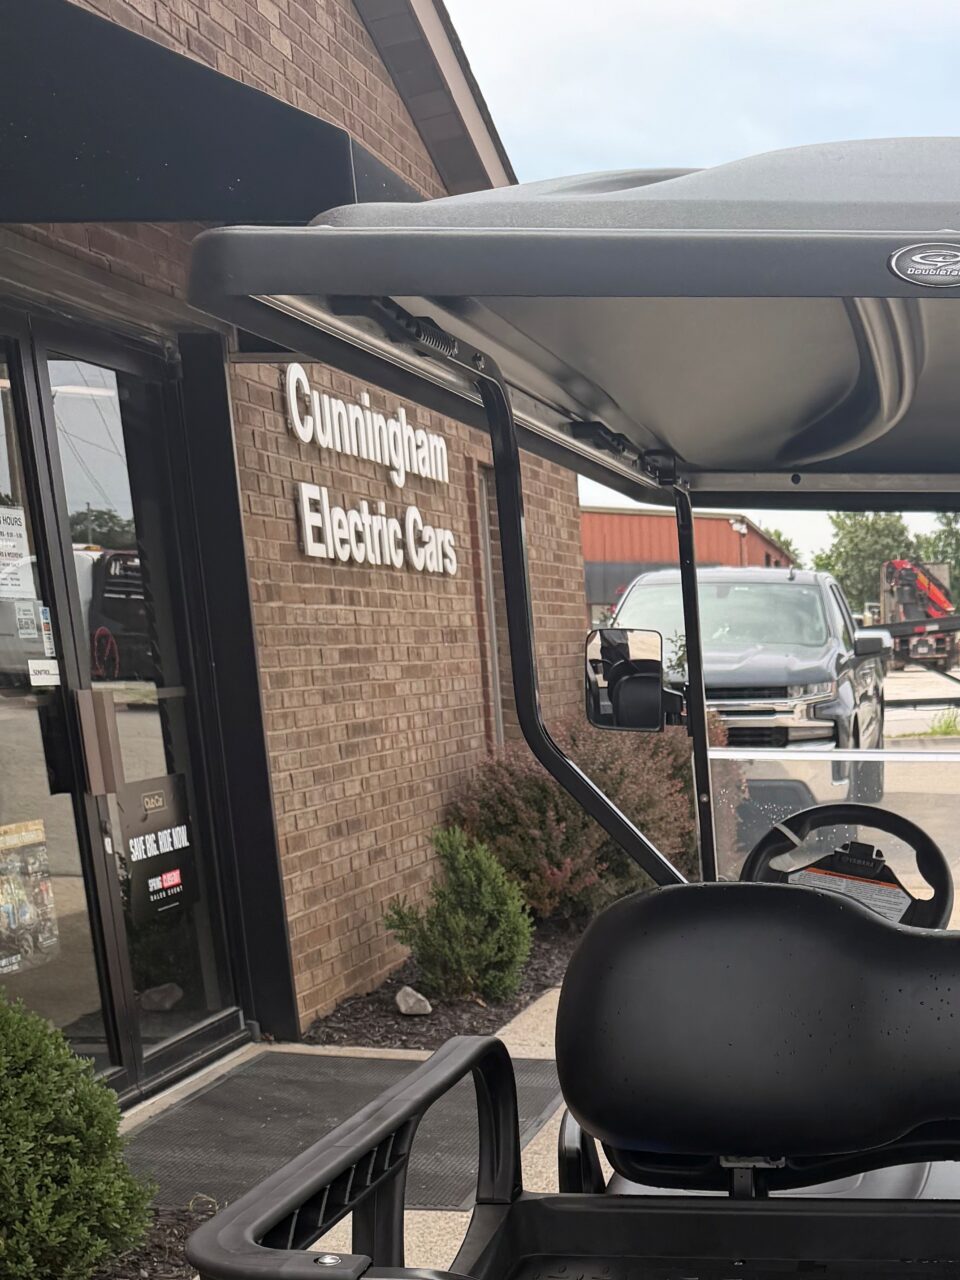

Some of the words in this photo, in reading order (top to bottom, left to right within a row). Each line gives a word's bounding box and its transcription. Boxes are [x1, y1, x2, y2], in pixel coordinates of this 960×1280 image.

[286, 362, 449, 488] Cunningham
[299, 482, 404, 568] Electric
[405, 505, 457, 575] Cars
[129, 836, 147, 862] SAVE
[157, 829, 174, 854] RIDE
